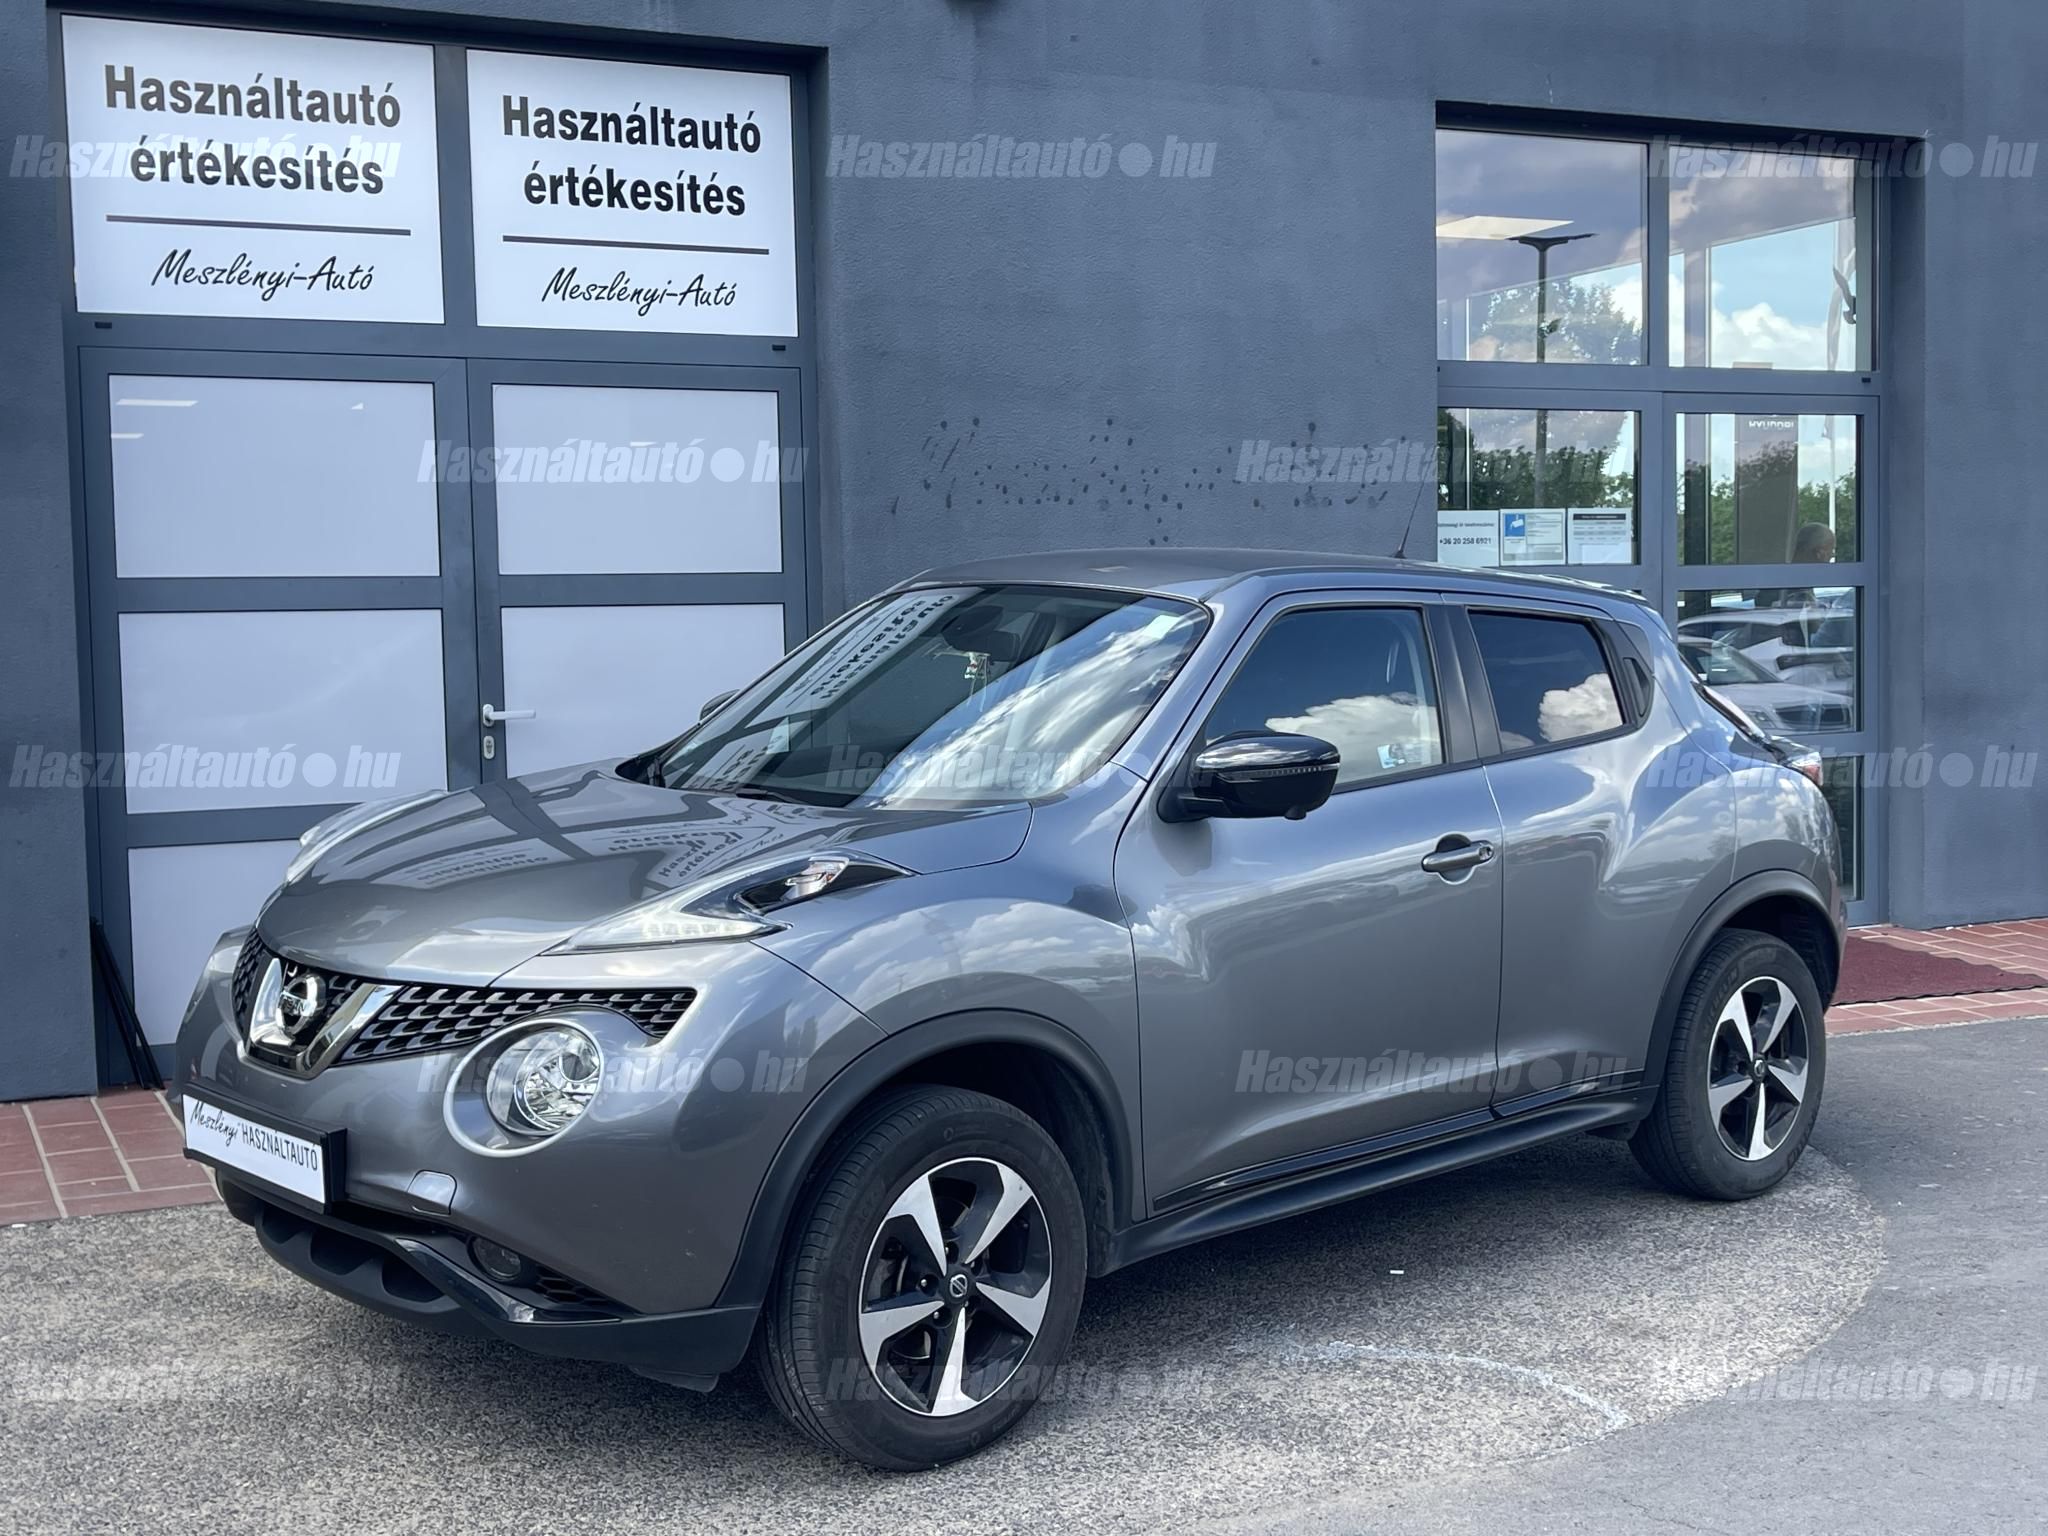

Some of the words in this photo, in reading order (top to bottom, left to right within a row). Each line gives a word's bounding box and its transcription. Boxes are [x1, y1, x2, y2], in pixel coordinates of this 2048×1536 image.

[106, 64, 400, 128] Használtautó
[502, 94, 761, 154] Használtautó
[130, 136, 384, 194] értékesítés
[524, 160, 746, 217] értékesítés
[152, 247, 375, 302] Meszlényi-Autó
[541, 266, 737, 317] Meszlényi-Autó
[241, 1122, 318, 1172] HASZNÁLTAUTÓ
